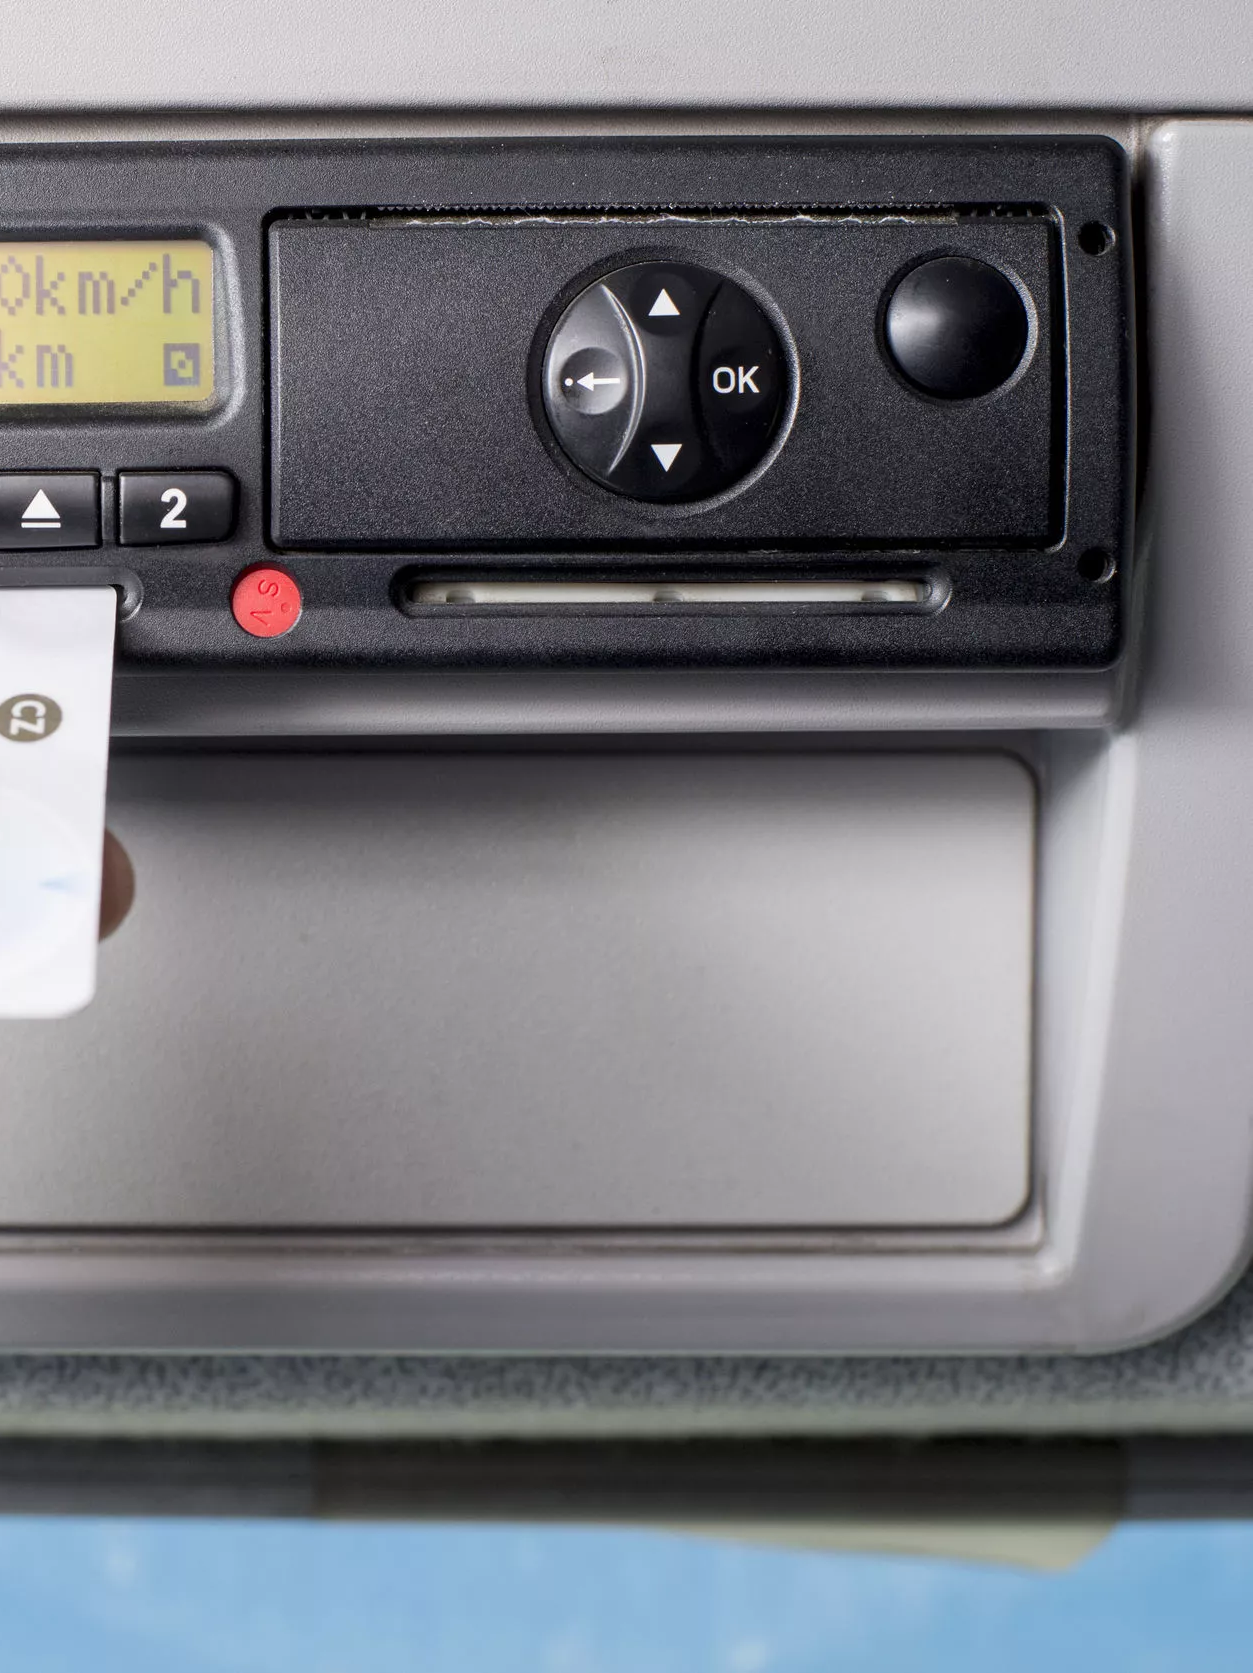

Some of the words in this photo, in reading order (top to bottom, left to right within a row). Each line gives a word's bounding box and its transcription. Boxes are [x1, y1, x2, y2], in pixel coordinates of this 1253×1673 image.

[712, 366, 760, 394] OK
[159, 487, 188, 529] 2
[9, 699, 47, 736] CZ
